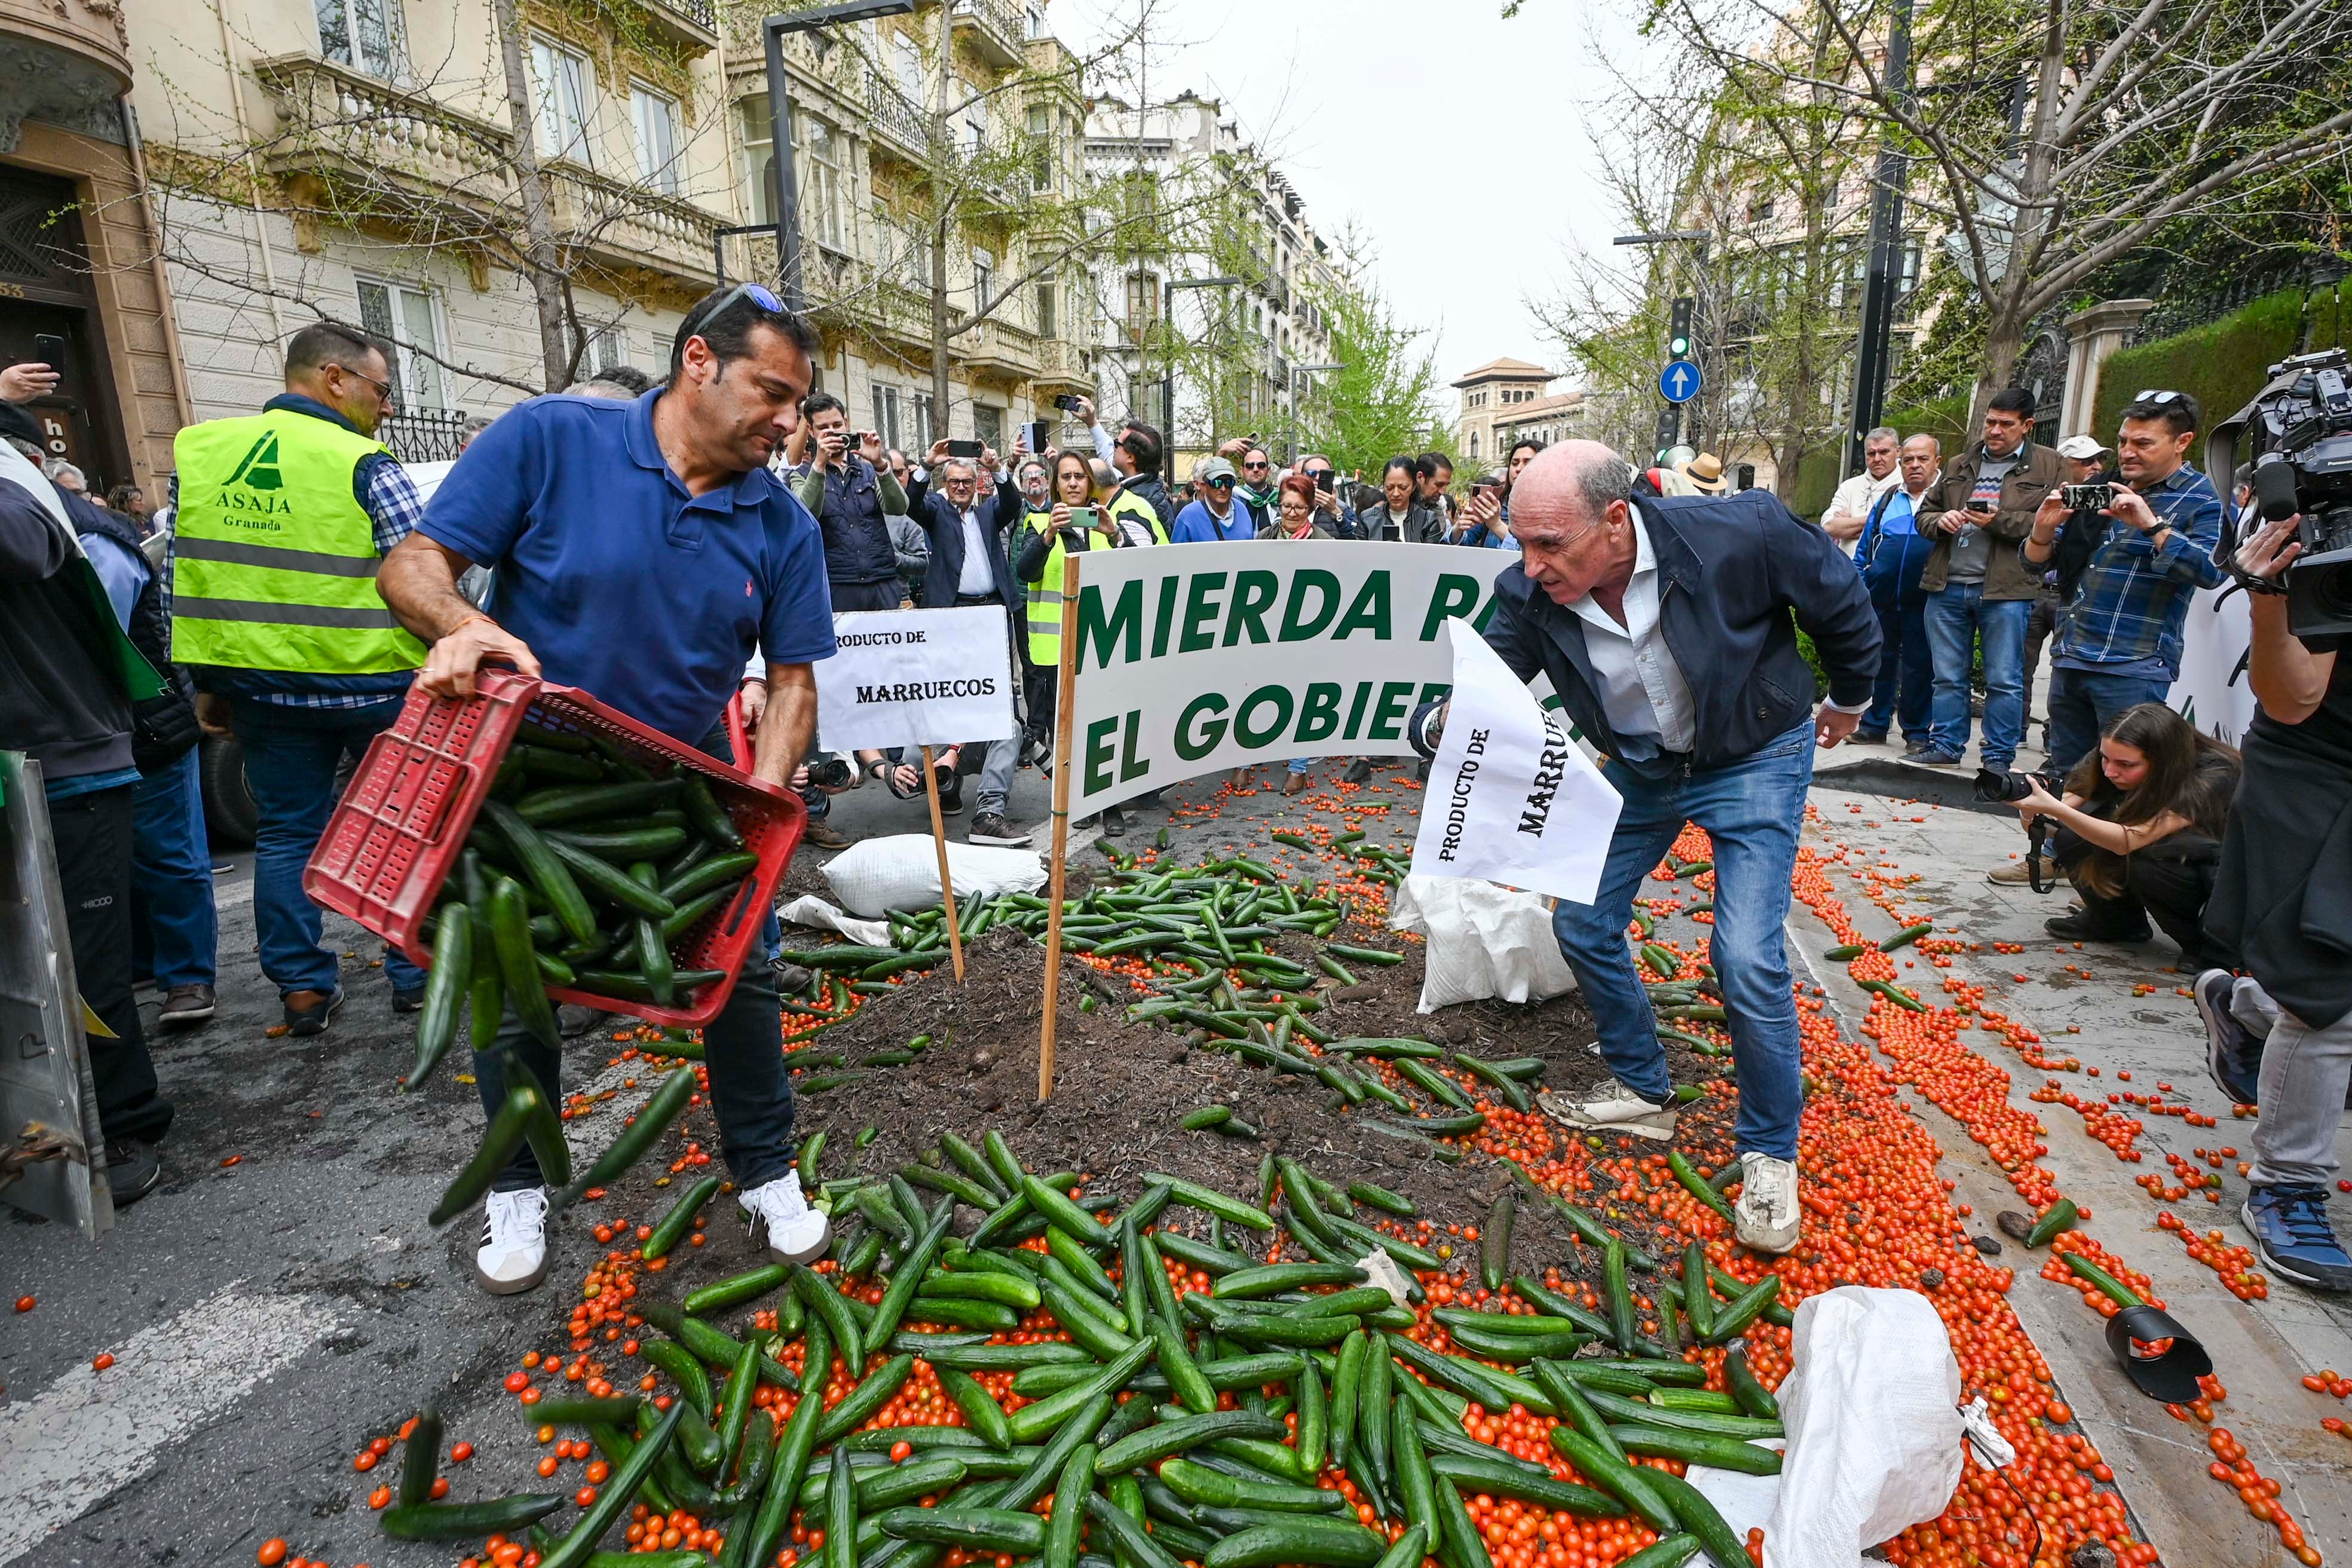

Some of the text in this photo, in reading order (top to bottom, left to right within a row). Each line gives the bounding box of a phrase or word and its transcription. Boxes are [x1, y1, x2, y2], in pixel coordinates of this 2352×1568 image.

[216, 492, 292, 514] ASAJA
[223, 515, 281, 531] Granada
[836, 631, 927, 648] RODUCTO DE
[1075, 569, 1392, 675] MIERDA
[856, 678, 996, 704] MARRUECOS
[1083, 709, 1150, 798] EL
[1517, 698, 1569, 838] MARRUE
[1439, 728, 1490, 862] PRODUCTO DE
